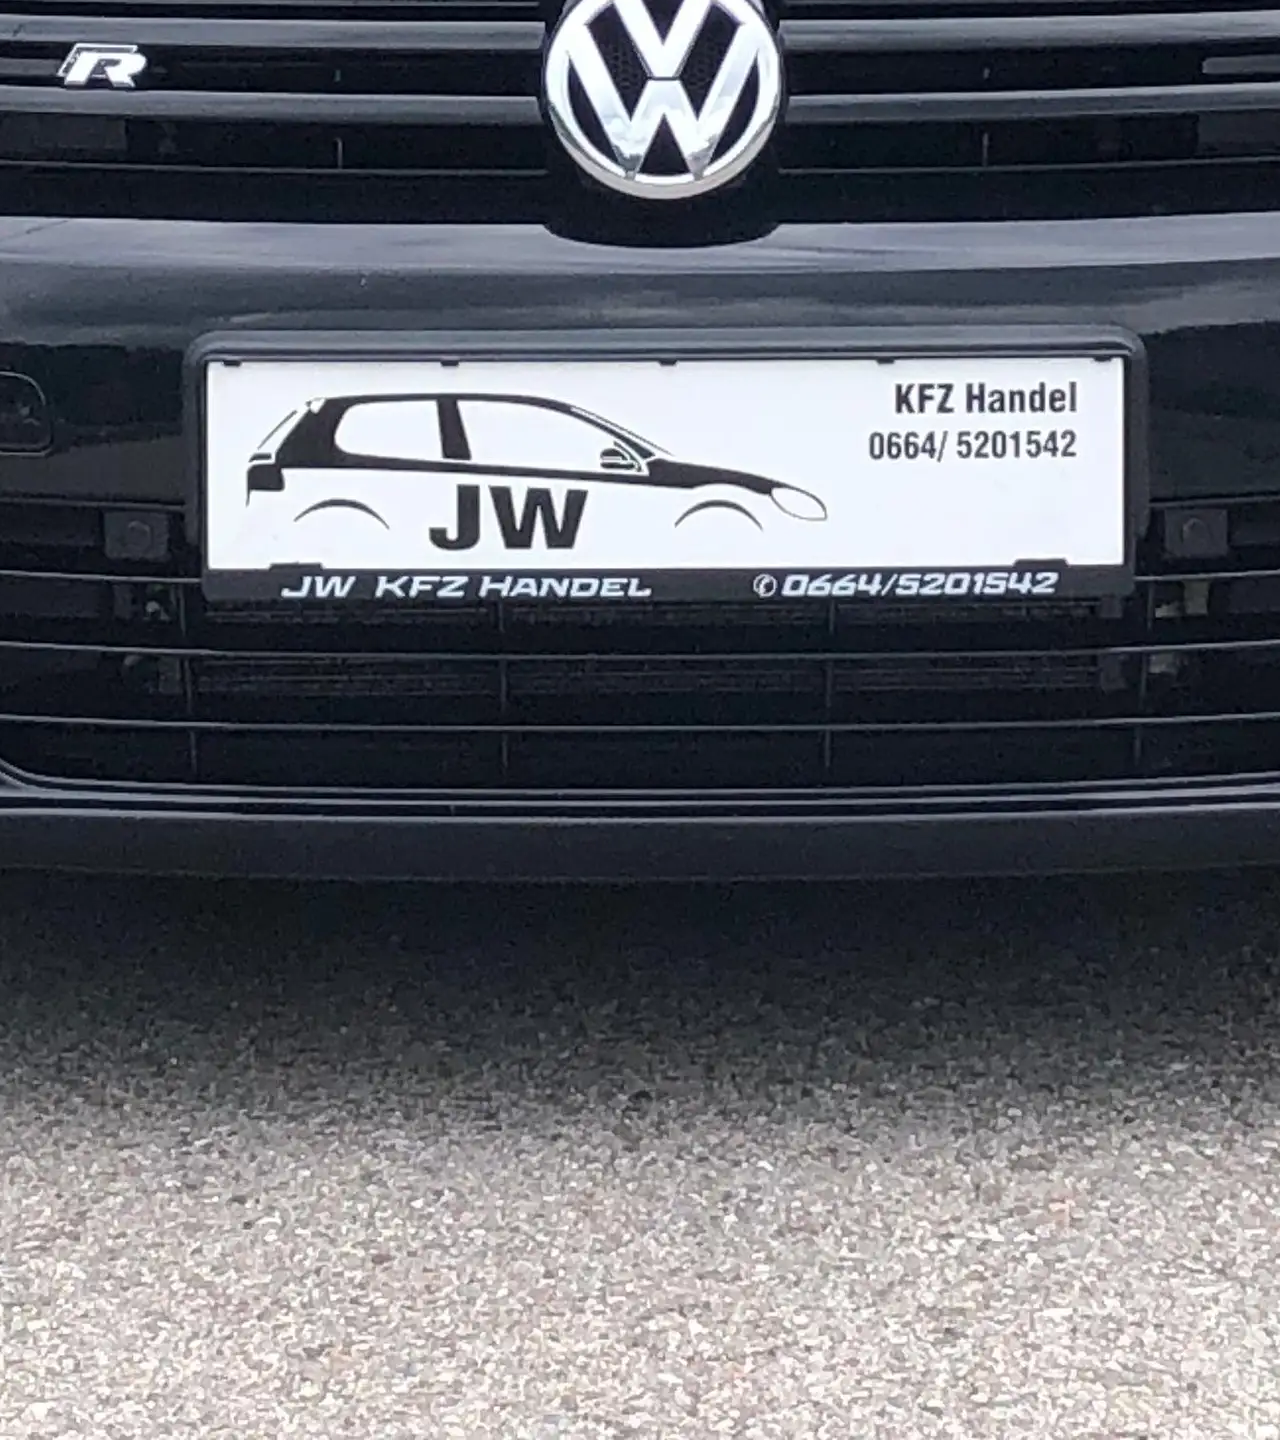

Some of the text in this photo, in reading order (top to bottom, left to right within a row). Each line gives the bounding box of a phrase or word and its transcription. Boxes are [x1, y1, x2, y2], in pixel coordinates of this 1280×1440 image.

[57, 42, 147, 88] R
[895, 381, 1077, 414] KFZ Handel
[869, 429, 1077, 462] 0664/ 5201542
[428, 484, 589, 551] JW
[280, 575, 652, 599] JW KFZ HANDEL
[780, 571, 1060, 597] 0664/5201542
